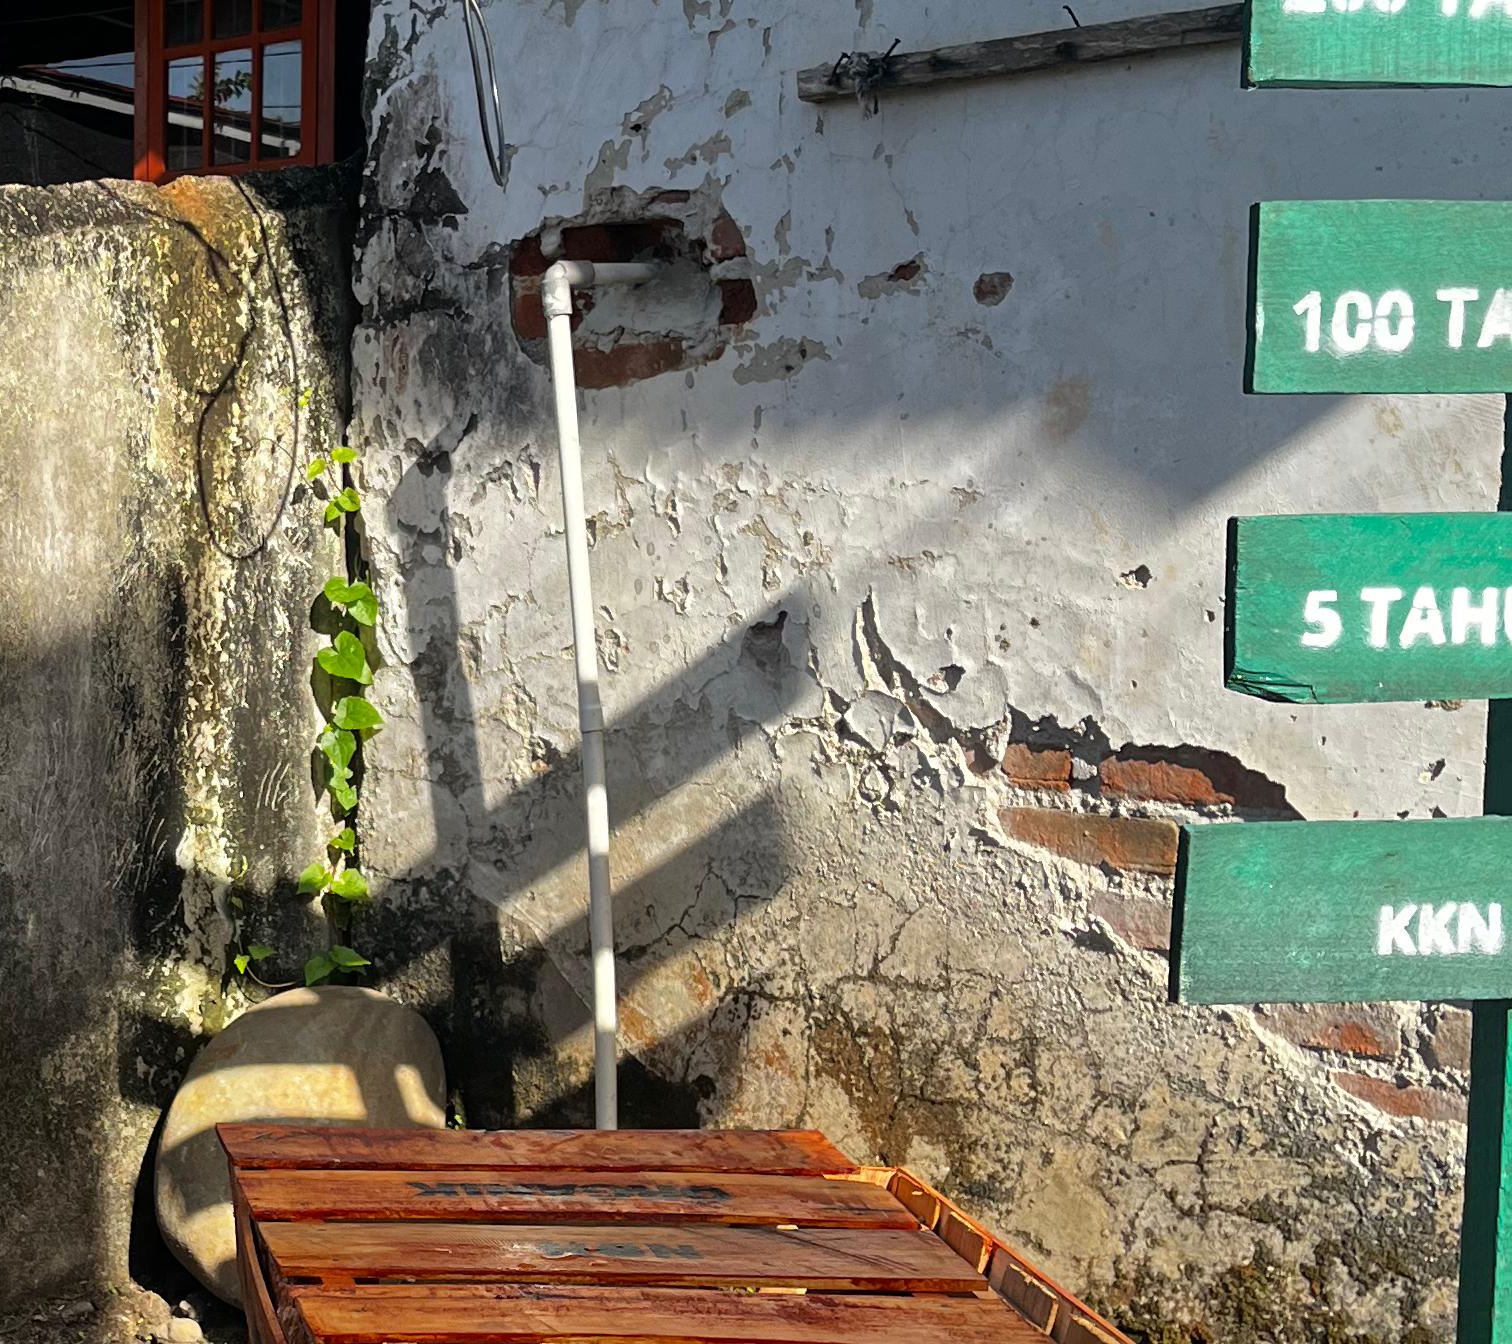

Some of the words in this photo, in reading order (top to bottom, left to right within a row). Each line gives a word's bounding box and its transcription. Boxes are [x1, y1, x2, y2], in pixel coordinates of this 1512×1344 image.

[1292, 289, 1416, 352] 100
[1301, 589, 1343, 649] 5
[1360, 585, 1512, 650] TAH
[1376, 901, 1504, 957] KKN
